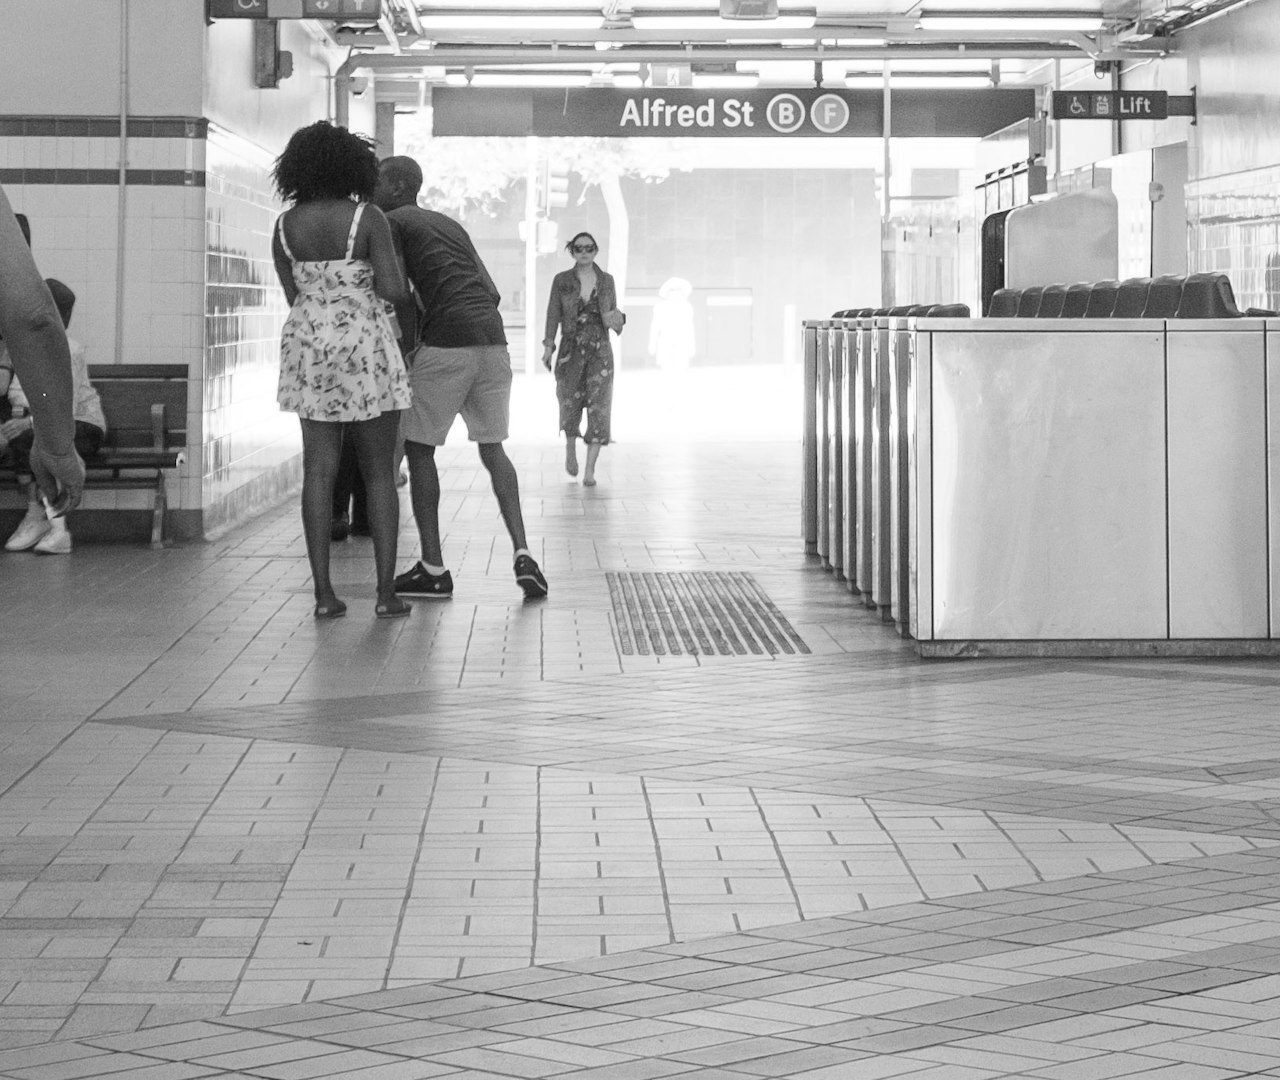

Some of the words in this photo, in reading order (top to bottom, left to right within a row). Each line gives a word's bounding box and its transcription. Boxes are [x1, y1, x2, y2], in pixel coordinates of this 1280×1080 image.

[619, 98, 715, 128] Alfred
[722, 98, 755, 128] St
[778, 102, 795, 125] B
[823, 102, 837, 125] F
[1120, 96, 1151, 114] Lift
